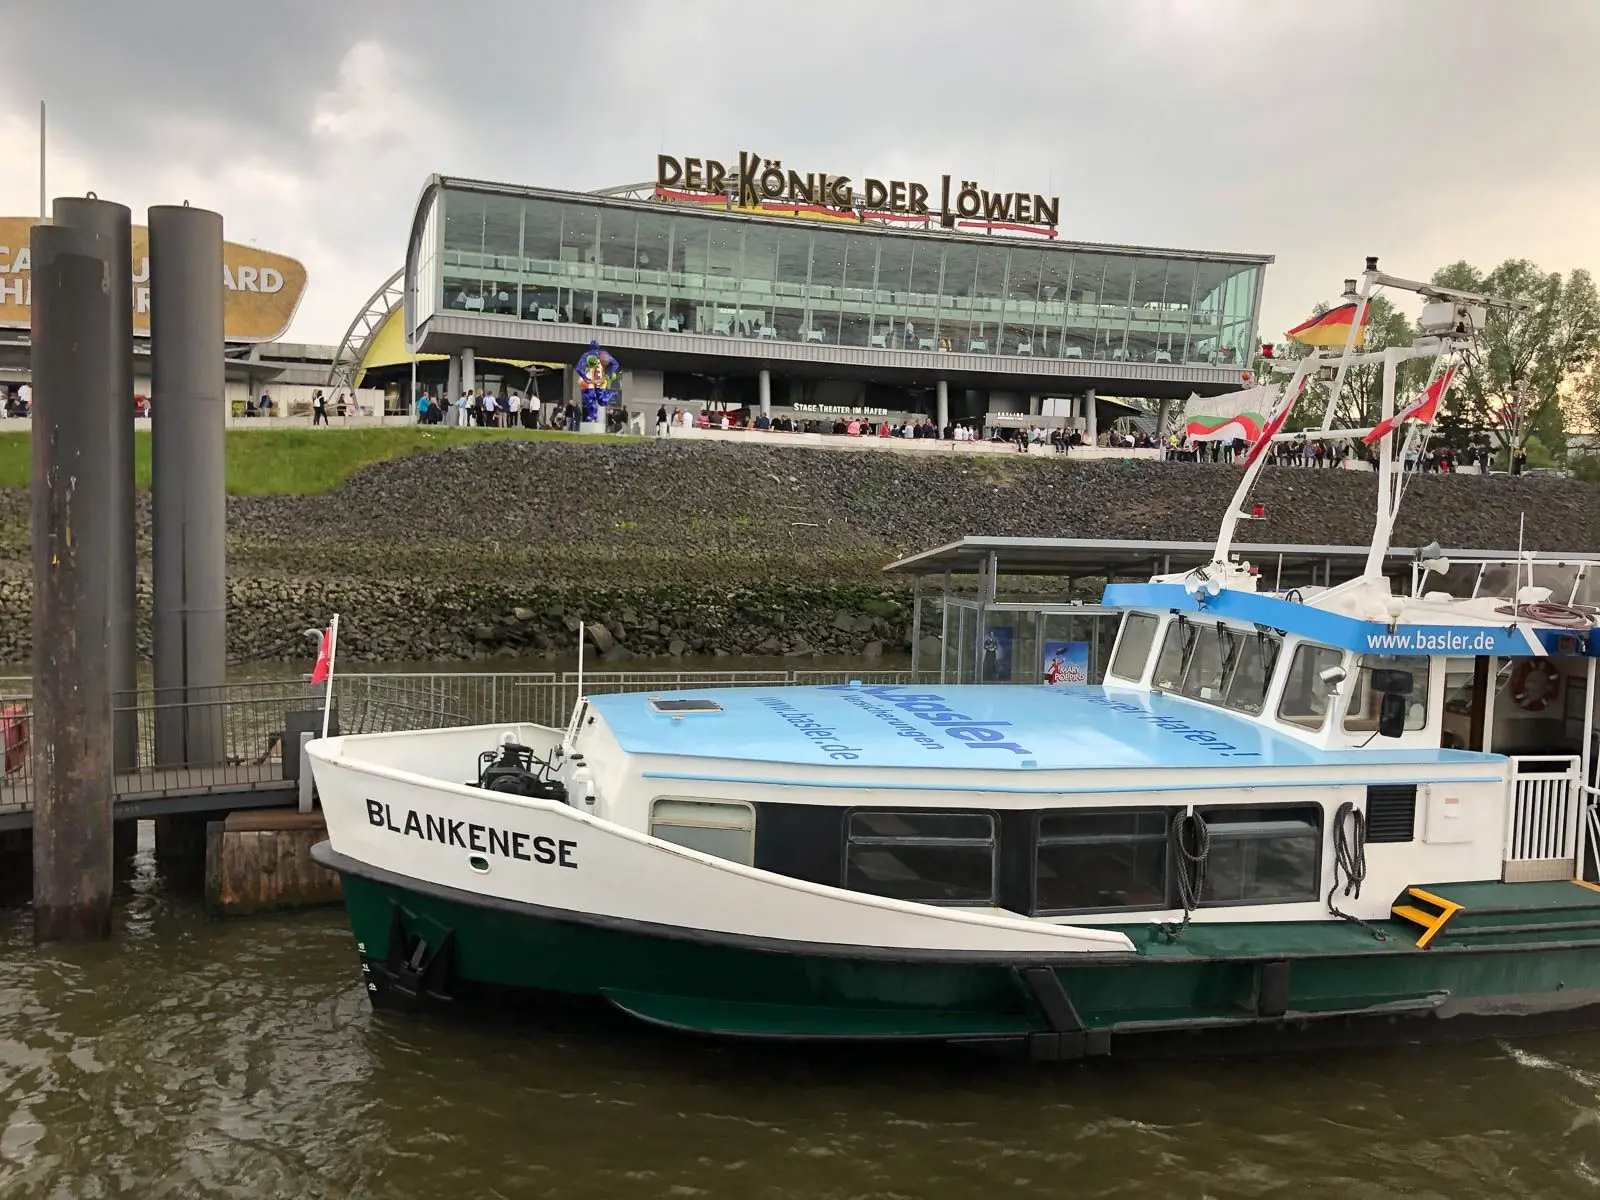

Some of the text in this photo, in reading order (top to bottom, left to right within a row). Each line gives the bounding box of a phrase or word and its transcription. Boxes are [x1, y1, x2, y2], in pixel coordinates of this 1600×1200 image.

[657, 151, 1060, 228] DER KÖNIG DER LÖWEN
[793, 402, 817, 412] STAGE
[818, 404, 850, 414] THEATER
[863, 406, 888, 416] HAFEN
[1367, 630, 1495, 650] www.basler.de
[1054, 672, 1086, 681] POPPINS
[1059, 666, 1081, 674] MARY
[753, 696, 863, 760] www.basler.de
[872, 694, 1033, 755] Basler
[1137, 716, 1261, 757] Hafen!
[365, 798, 578, 869] BLANKENESE
